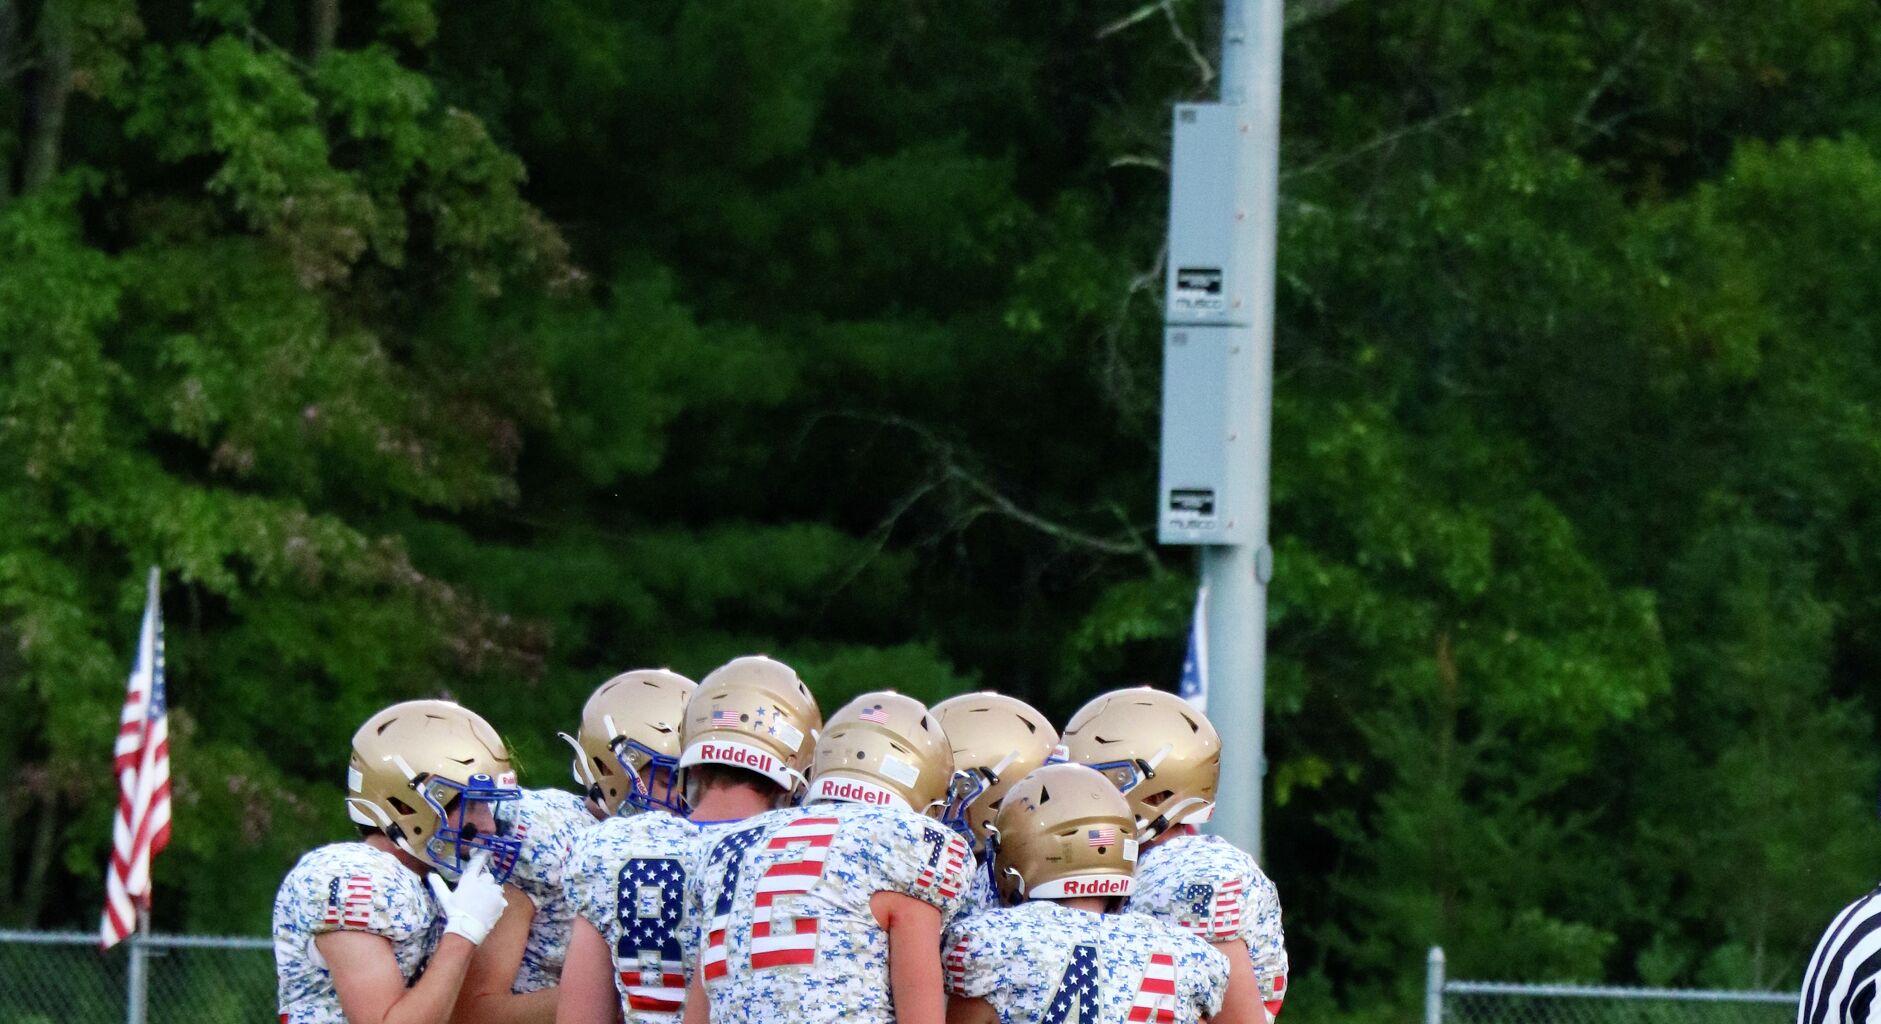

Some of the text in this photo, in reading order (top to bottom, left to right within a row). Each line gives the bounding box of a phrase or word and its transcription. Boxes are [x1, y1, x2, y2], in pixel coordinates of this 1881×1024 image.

[700, 744, 772, 772] Riddell
[821, 780, 891, 806] Riddell
[703, 816, 840, 982] 72
[1063, 879, 1130, 895] Riddell
